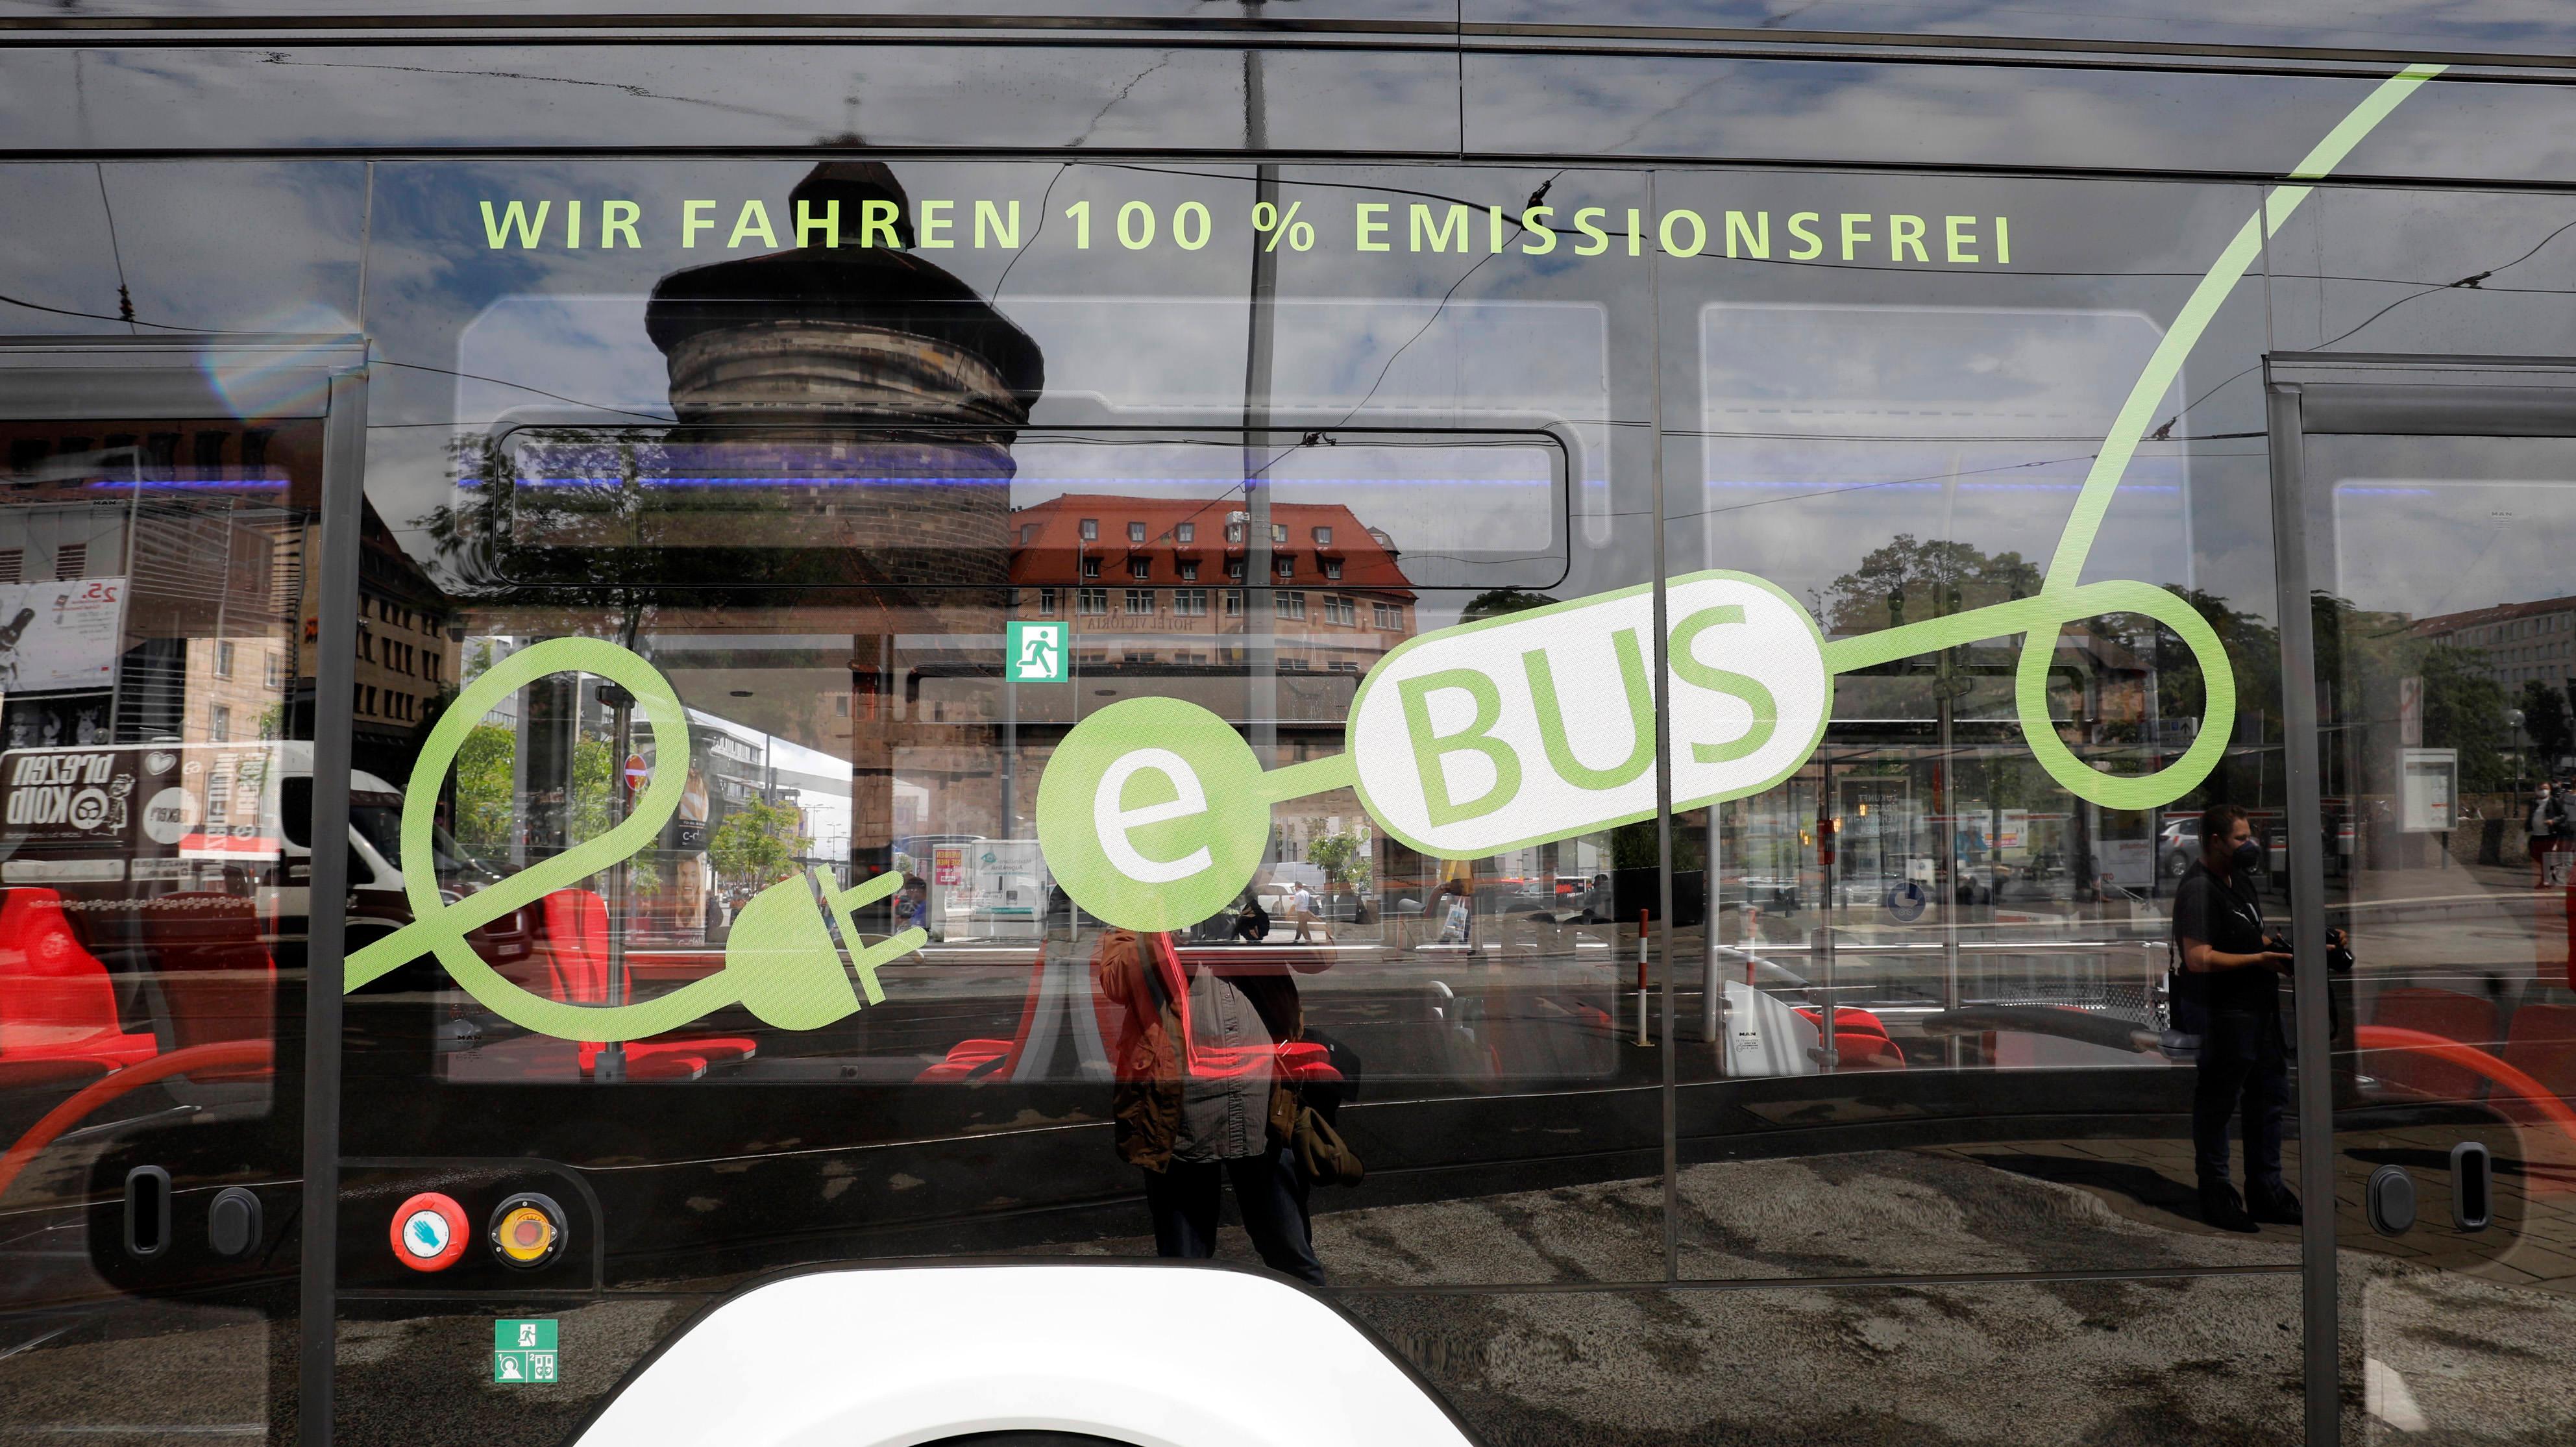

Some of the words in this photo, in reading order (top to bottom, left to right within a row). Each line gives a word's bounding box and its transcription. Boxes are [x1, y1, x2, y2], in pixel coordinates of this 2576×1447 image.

[480, 200, 642, 249] WIR
[682, 200, 1020, 249] FAHREN
[1067, 201, 1211, 250] 100
[1251, 201, 1315, 252] %
[1356, 203, 2010, 264] EMISSIONSFREI
[1094, 748, 1212, 884] e
[1397, 604, 1778, 828] BUS
